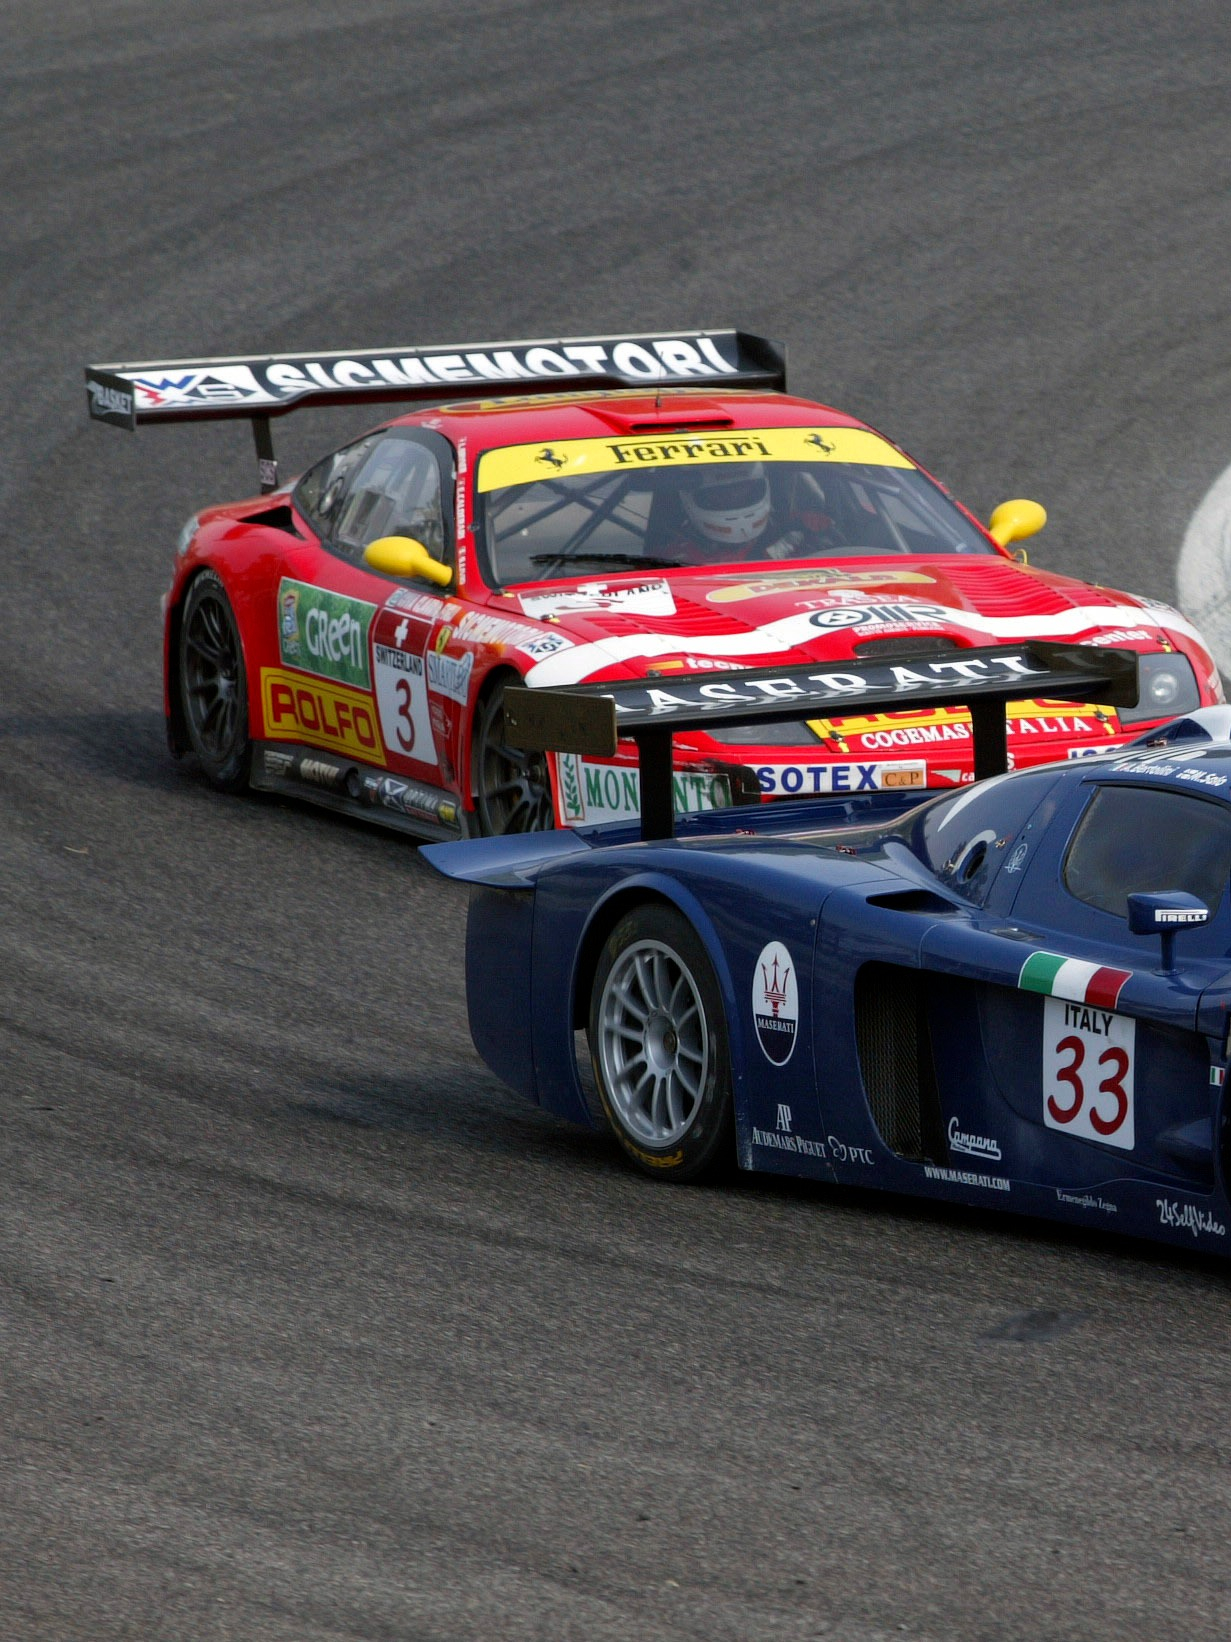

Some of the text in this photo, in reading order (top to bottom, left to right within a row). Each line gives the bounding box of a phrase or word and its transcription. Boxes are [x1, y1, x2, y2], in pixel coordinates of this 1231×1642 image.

[605, 436, 772, 464] Ferrari
[375, 645, 423, 677] SWITZERLAND
[601, 655, 1050, 713] ASERATI
[396, 678, 416, 752] 3
[861, 716, 1093, 750] COGEMAS TALIA
[584, 766, 733, 814] MONNTO
[757, 764, 879, 793] SOTEX
[1154, 908, 1209, 923] PIRELLI
[756, 1016, 795, 1034] MASERATI
[1064, 1003, 1114, 1037] ITALY
[1047, 1035, 1130, 1136] 33
[751, 1126, 827, 1159] AUDEMARS PIGUET
[924, 1165, 1011, 1192] WWW.MASERATI.COM
